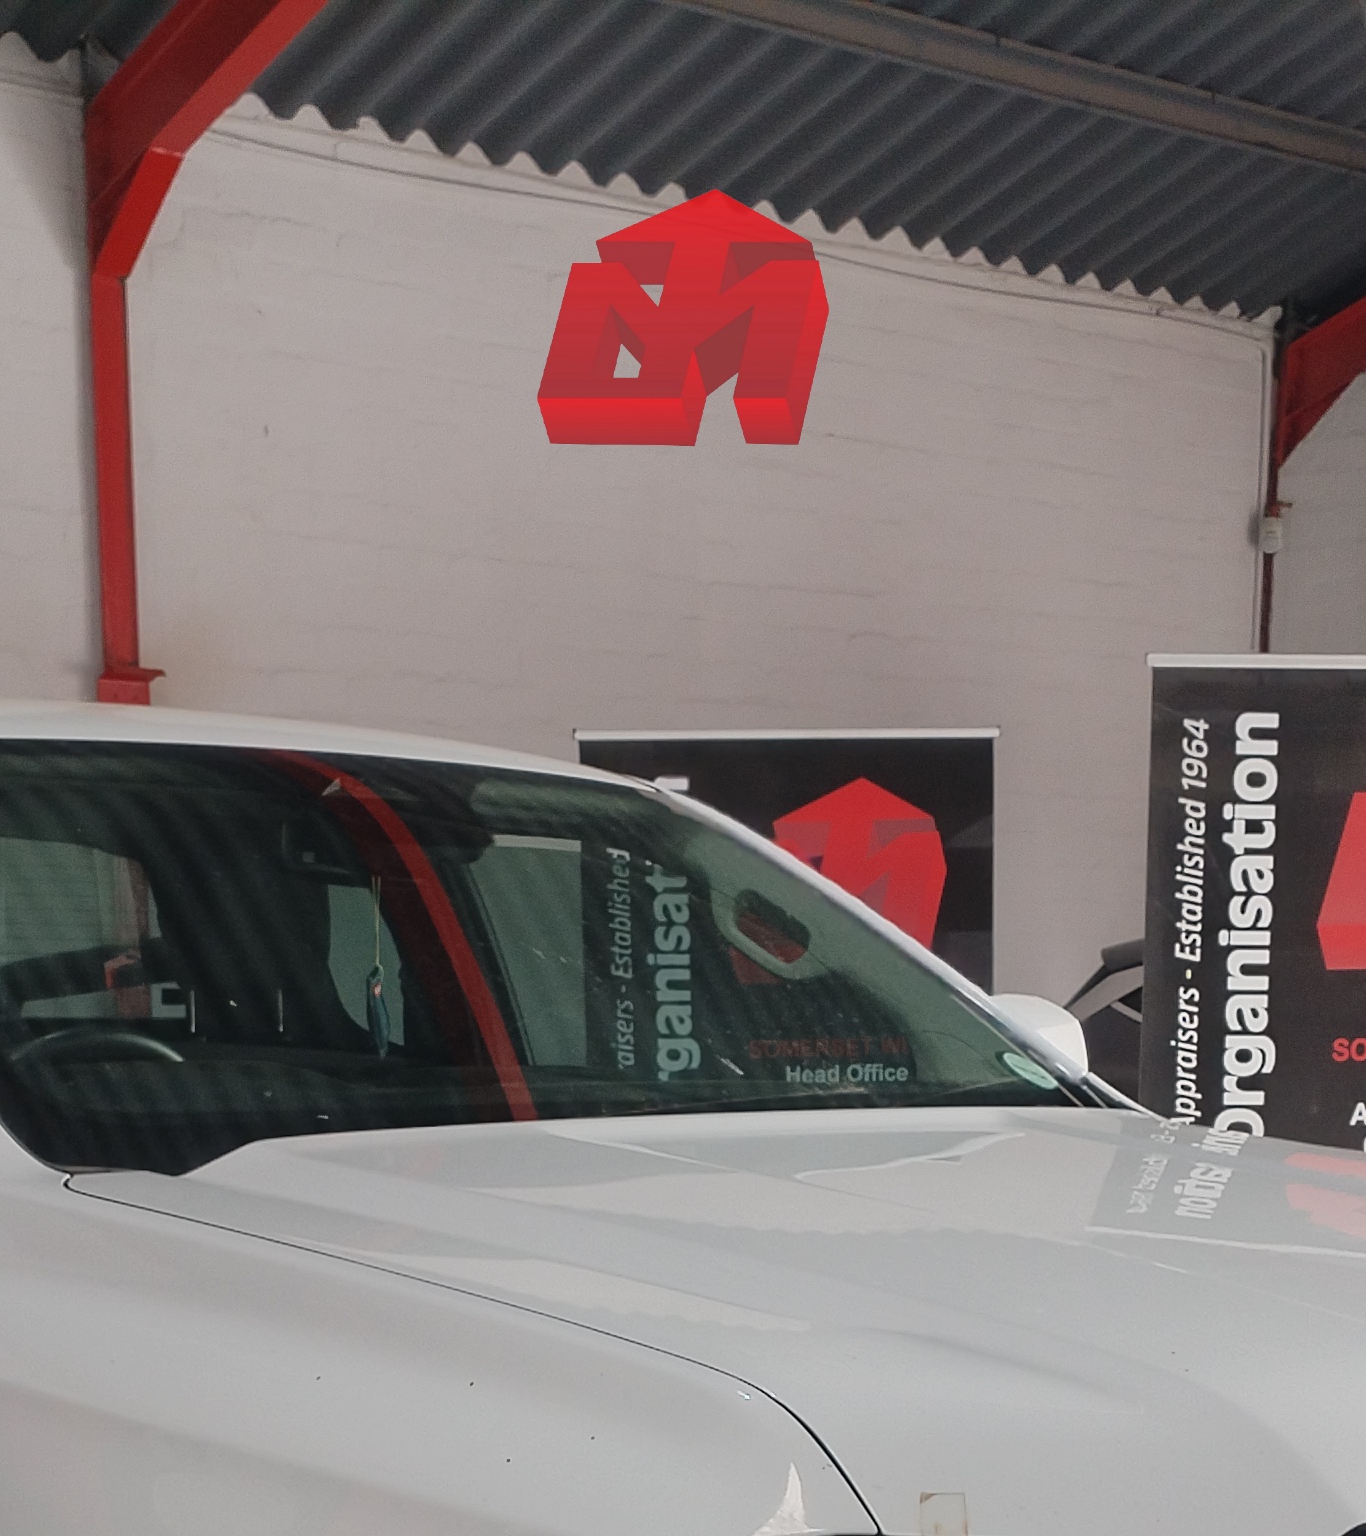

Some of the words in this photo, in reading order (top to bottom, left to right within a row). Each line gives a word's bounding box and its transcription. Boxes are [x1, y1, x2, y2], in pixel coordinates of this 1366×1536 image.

[1181, 718, 1209, 790] 1964
[1174, 798, 1207, 961] Established
[785, 1064, 840, 1084] Head
[846, 1062, 909, 1082] Office
